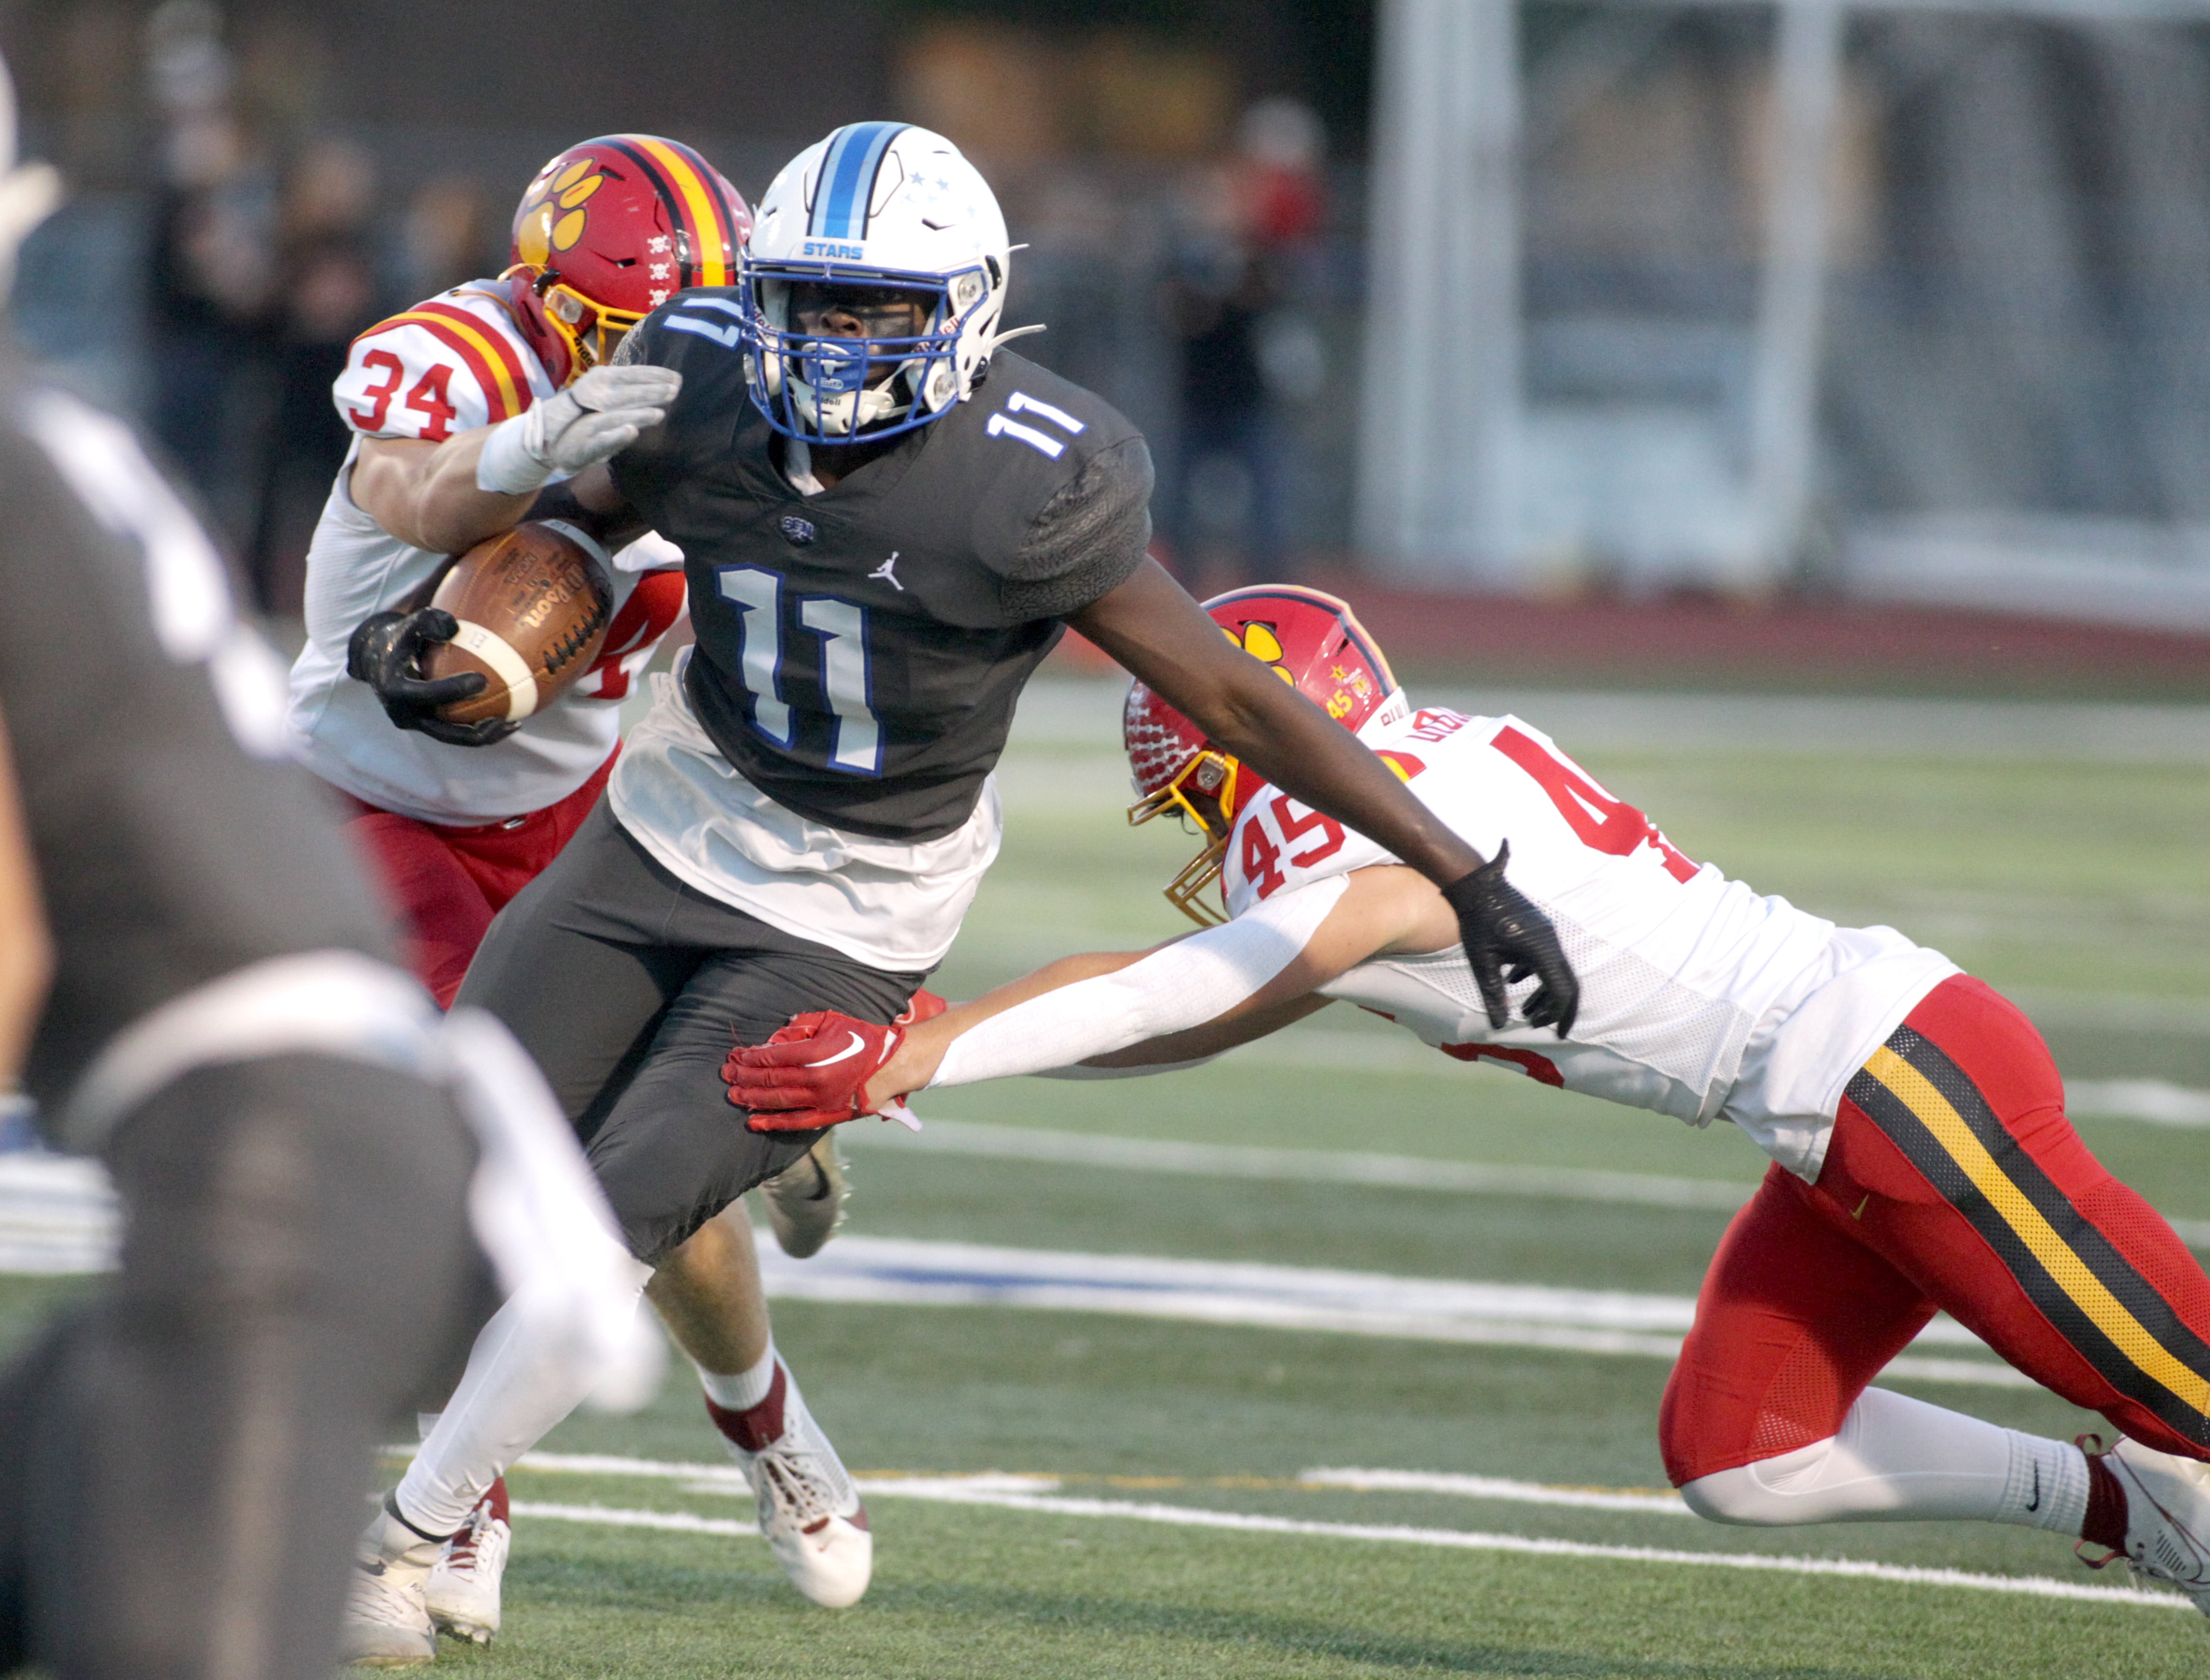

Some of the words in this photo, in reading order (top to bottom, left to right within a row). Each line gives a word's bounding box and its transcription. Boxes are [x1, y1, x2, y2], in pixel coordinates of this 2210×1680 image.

[802, 241, 863, 260] STARS
[350, 349, 456, 443] 34
[811, 394, 841, 406] Rdell
[985, 390, 1088, 461] 11
[713, 562, 883, 777] 11
[1326, 689, 1353, 719] 45
[1242, 792, 1346, 901] 45
